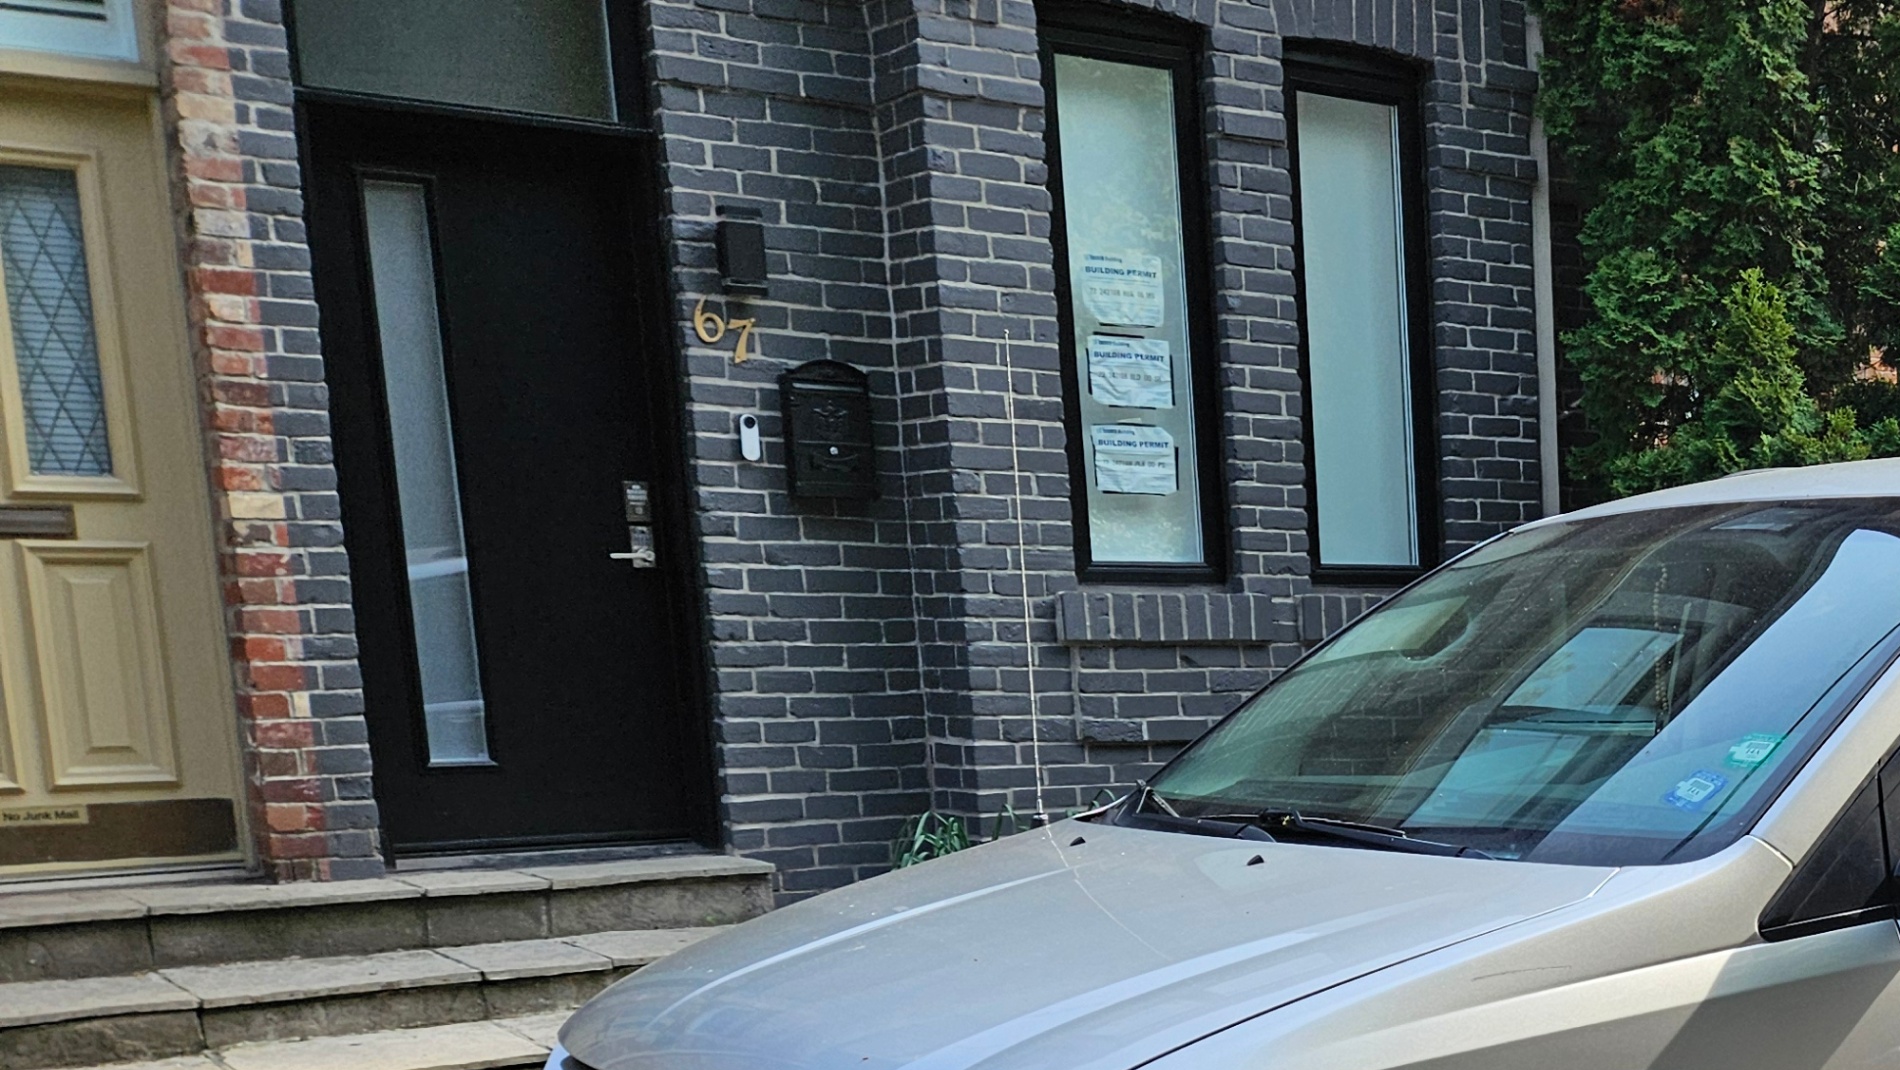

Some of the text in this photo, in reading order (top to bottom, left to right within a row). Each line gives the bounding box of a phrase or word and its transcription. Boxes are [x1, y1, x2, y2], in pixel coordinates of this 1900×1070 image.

[1085, 265, 1157, 279] BUILDING PERMIT
[694, 295, 756, 363] 67
[1093, 350, 1165, 362] BUILDING PERMIT
[1098, 439, 1169, 449] BUILDING PERMIT
[2, 810, 80, 821] No Junk Mail
